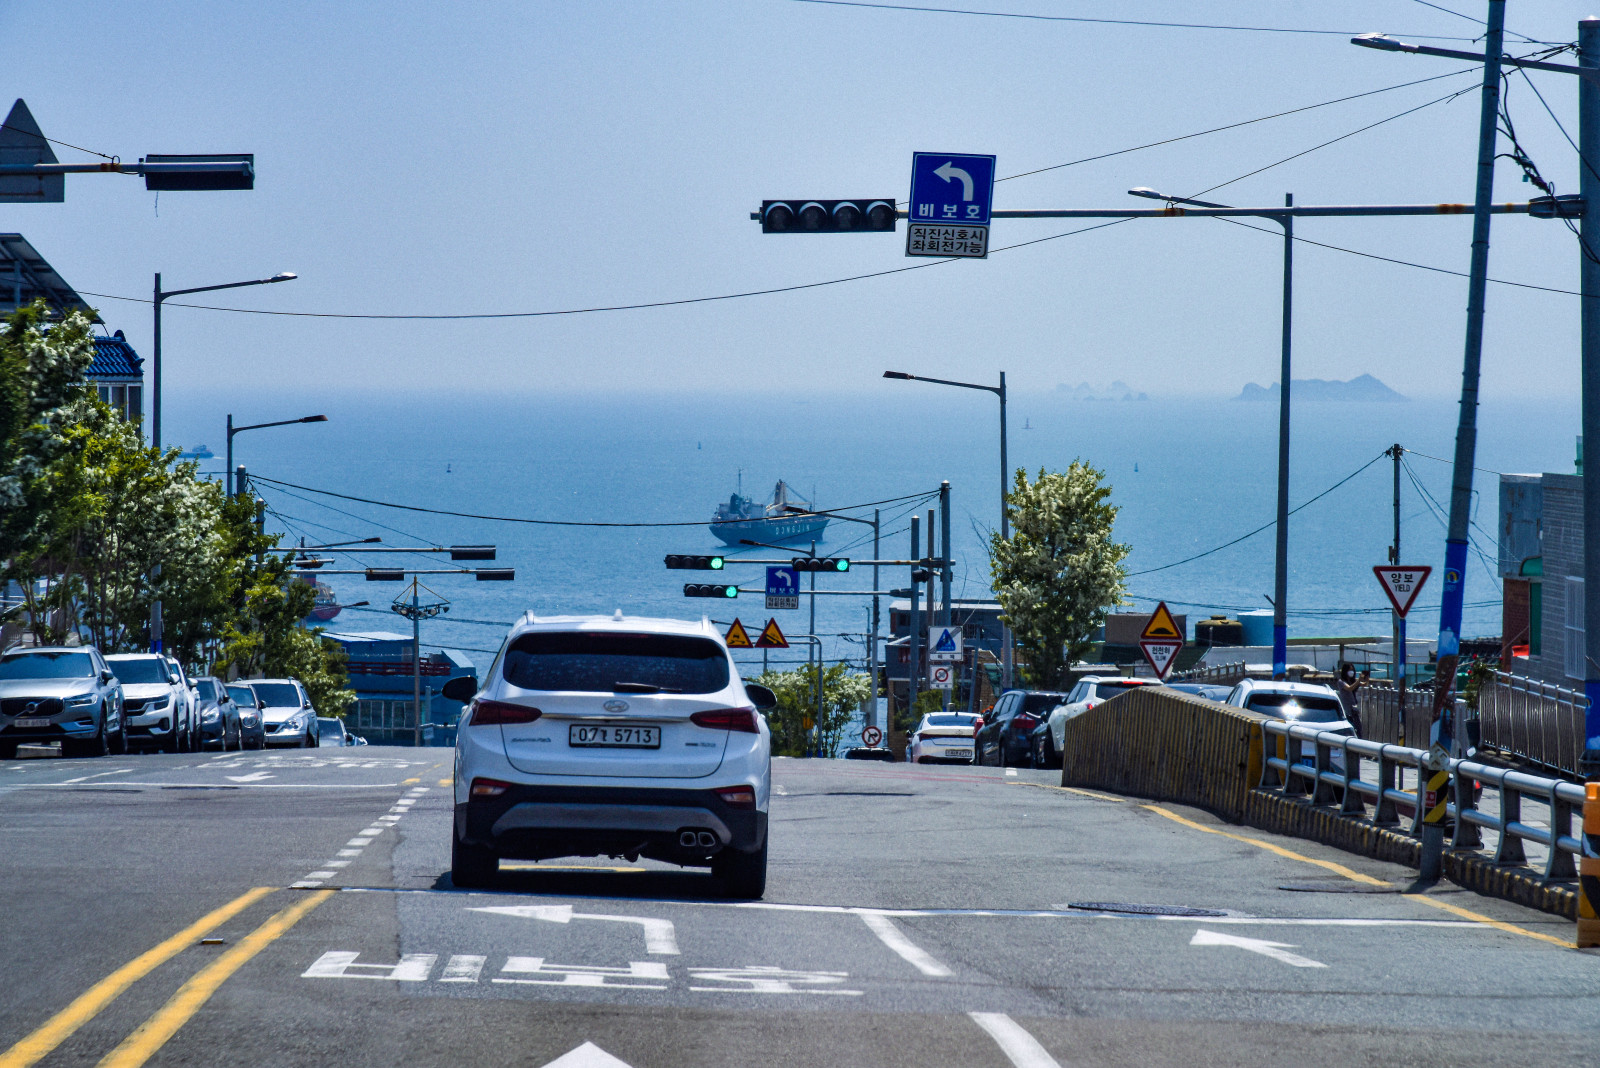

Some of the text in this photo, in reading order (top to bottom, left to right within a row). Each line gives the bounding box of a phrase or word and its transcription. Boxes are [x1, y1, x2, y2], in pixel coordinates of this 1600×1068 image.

[919, 203, 981, 218] 비보호
[913, 228, 983, 241] 직진신호시
[912, 241, 983, 253] 좌회전가능
[1391, 573, 1414, 583] 양보
[1395, 584, 1411, 592] YIELD
[614, 728, 652, 743] 5713
